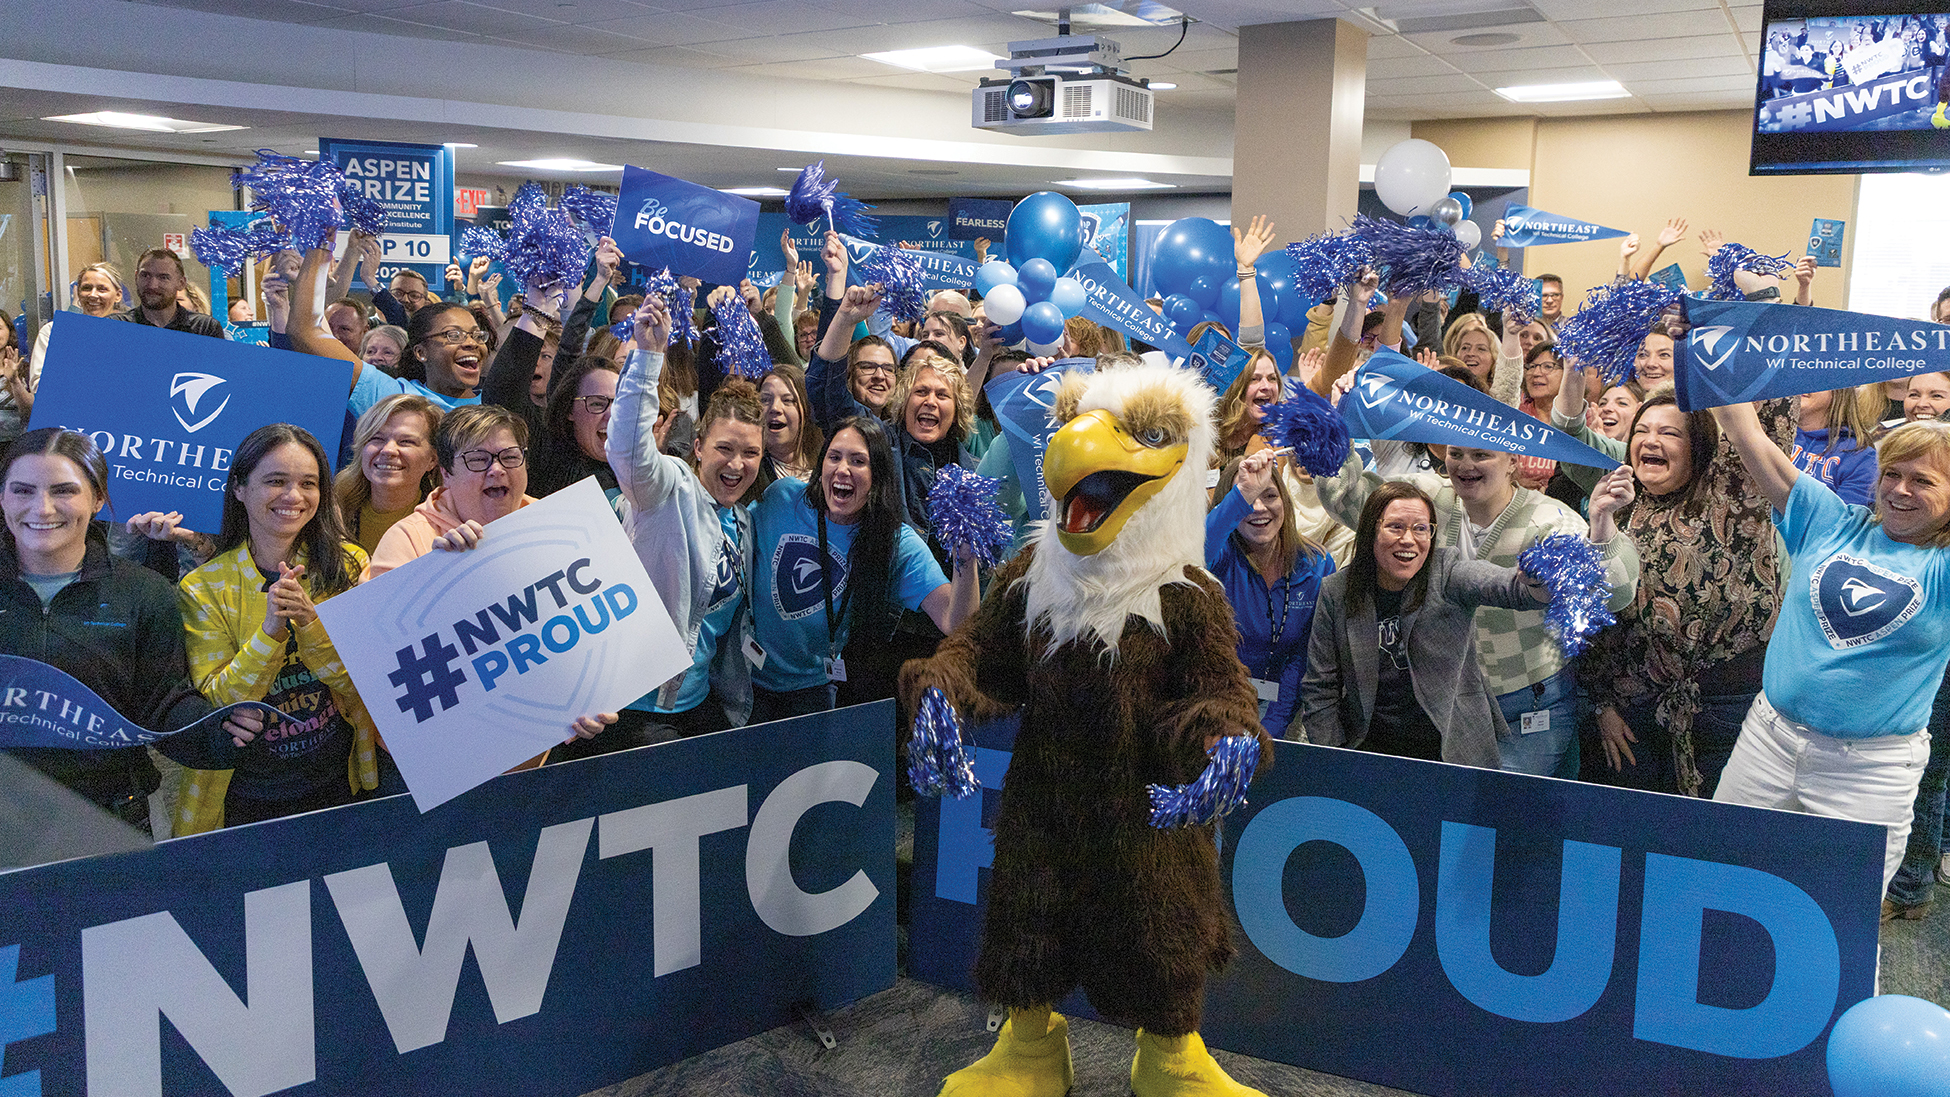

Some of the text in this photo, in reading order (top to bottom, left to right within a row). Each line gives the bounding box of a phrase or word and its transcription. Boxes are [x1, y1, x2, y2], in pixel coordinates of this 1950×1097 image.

[1776, 75, 1929, 128] #NWTC
[345, 157, 430, 180] ASPEN
[380, 202, 422, 211] OMMUNITY
[460, 188, 487, 215] EXIT
[640, 197, 669, 219] Be
[386, 211, 431, 220] XCELLENCE
[955, 216, 1006, 229] FEARLESS
[1525, 221, 1600, 235] NORTHEAST
[634, 211, 735, 254] FOCUSED
[908, 240, 965, 249] ORTHEAST
[940, 274, 972, 288] College
[1072, 269, 1176, 341] NORTHEAST
[1088, 296, 1156, 343] Technical College
[1745, 329, 1950, 354] NORTHEAST
[1766, 357, 1926, 372] WI Technical College
[1398, 389, 1554, 446] NORTHEAST
[1409, 409, 1526, 453] WI Technical College
[112, 464, 203, 489] Technical
[788, 535, 808, 543] NWTC
[1836, 554, 1864, 566] NWTC
[1819, 615, 1837, 641] PRIZE
[1845, 598, 1921, 648] NWTC ASPEN PRIZE
[471, 582, 639, 693] PROUD
[0, 759, 881, 1097] NWTC
